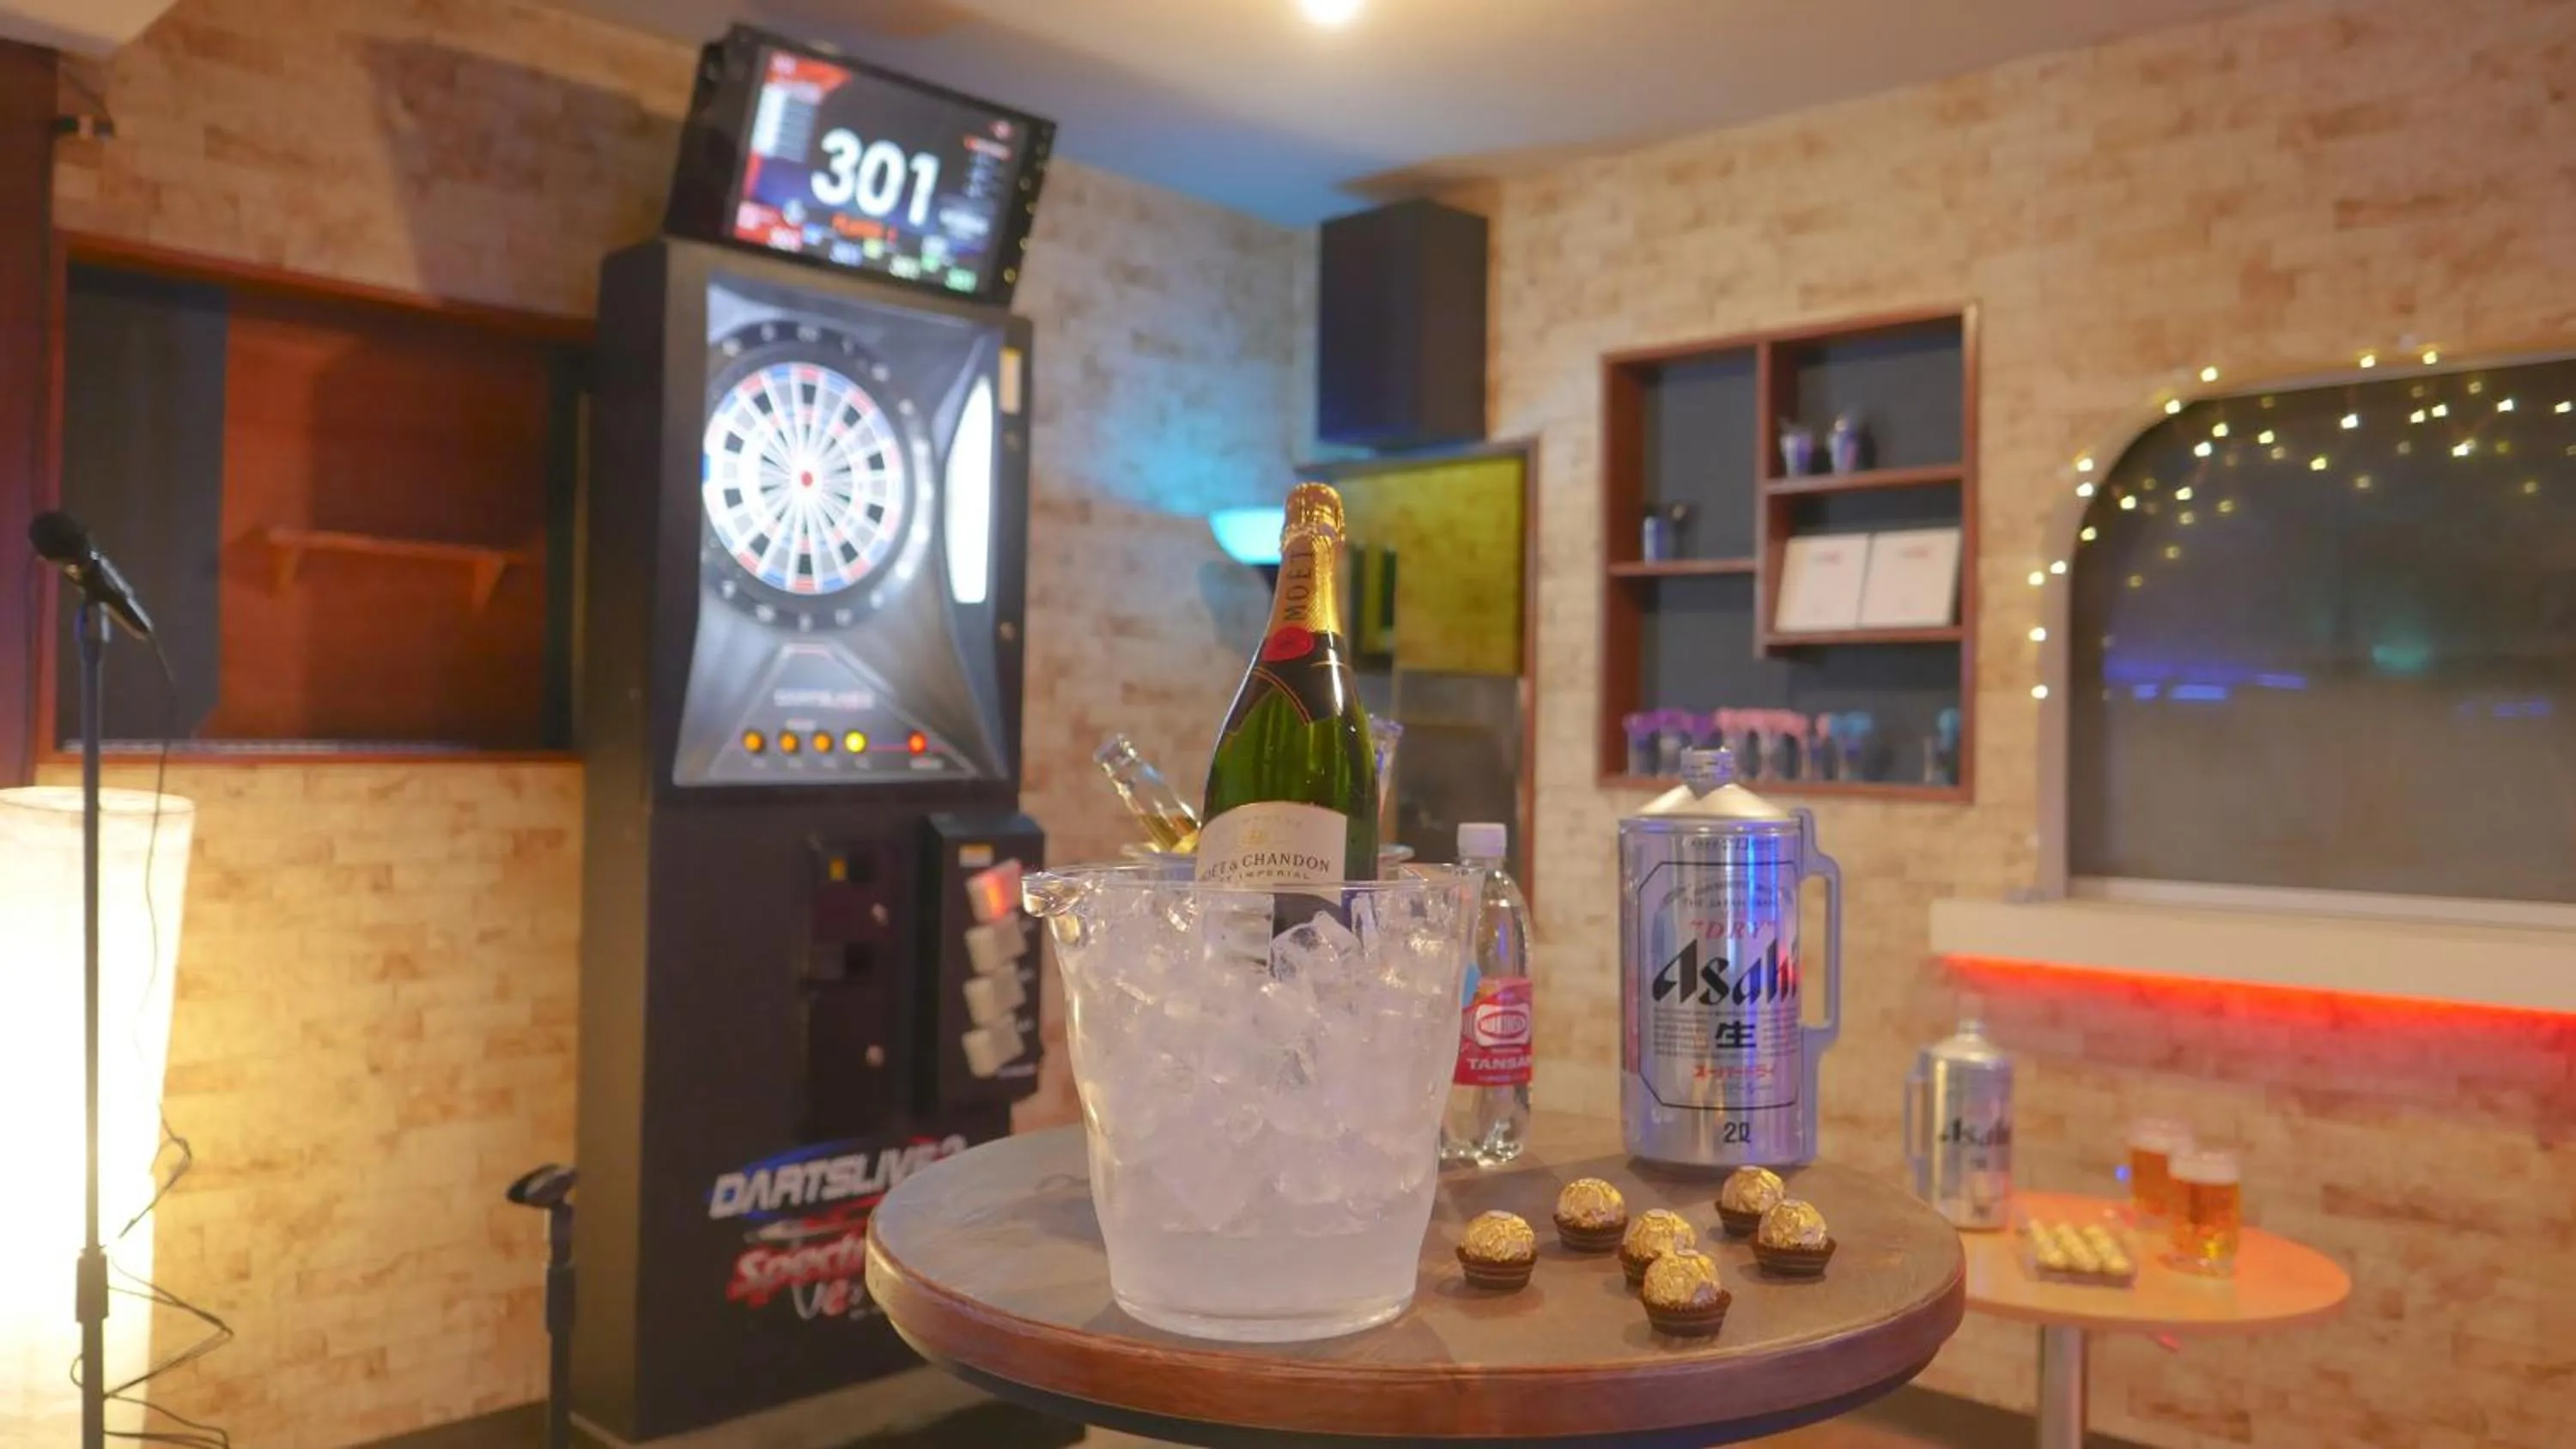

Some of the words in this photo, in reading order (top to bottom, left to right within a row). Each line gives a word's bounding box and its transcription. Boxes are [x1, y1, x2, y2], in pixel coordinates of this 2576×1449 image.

[811, 128, 939, 227] 301
[1242, 852, 1331, 873] CHANDON
[1651, 938, 1797, 1006] Asahi
[1714, 1020, 1757, 1049] 生
